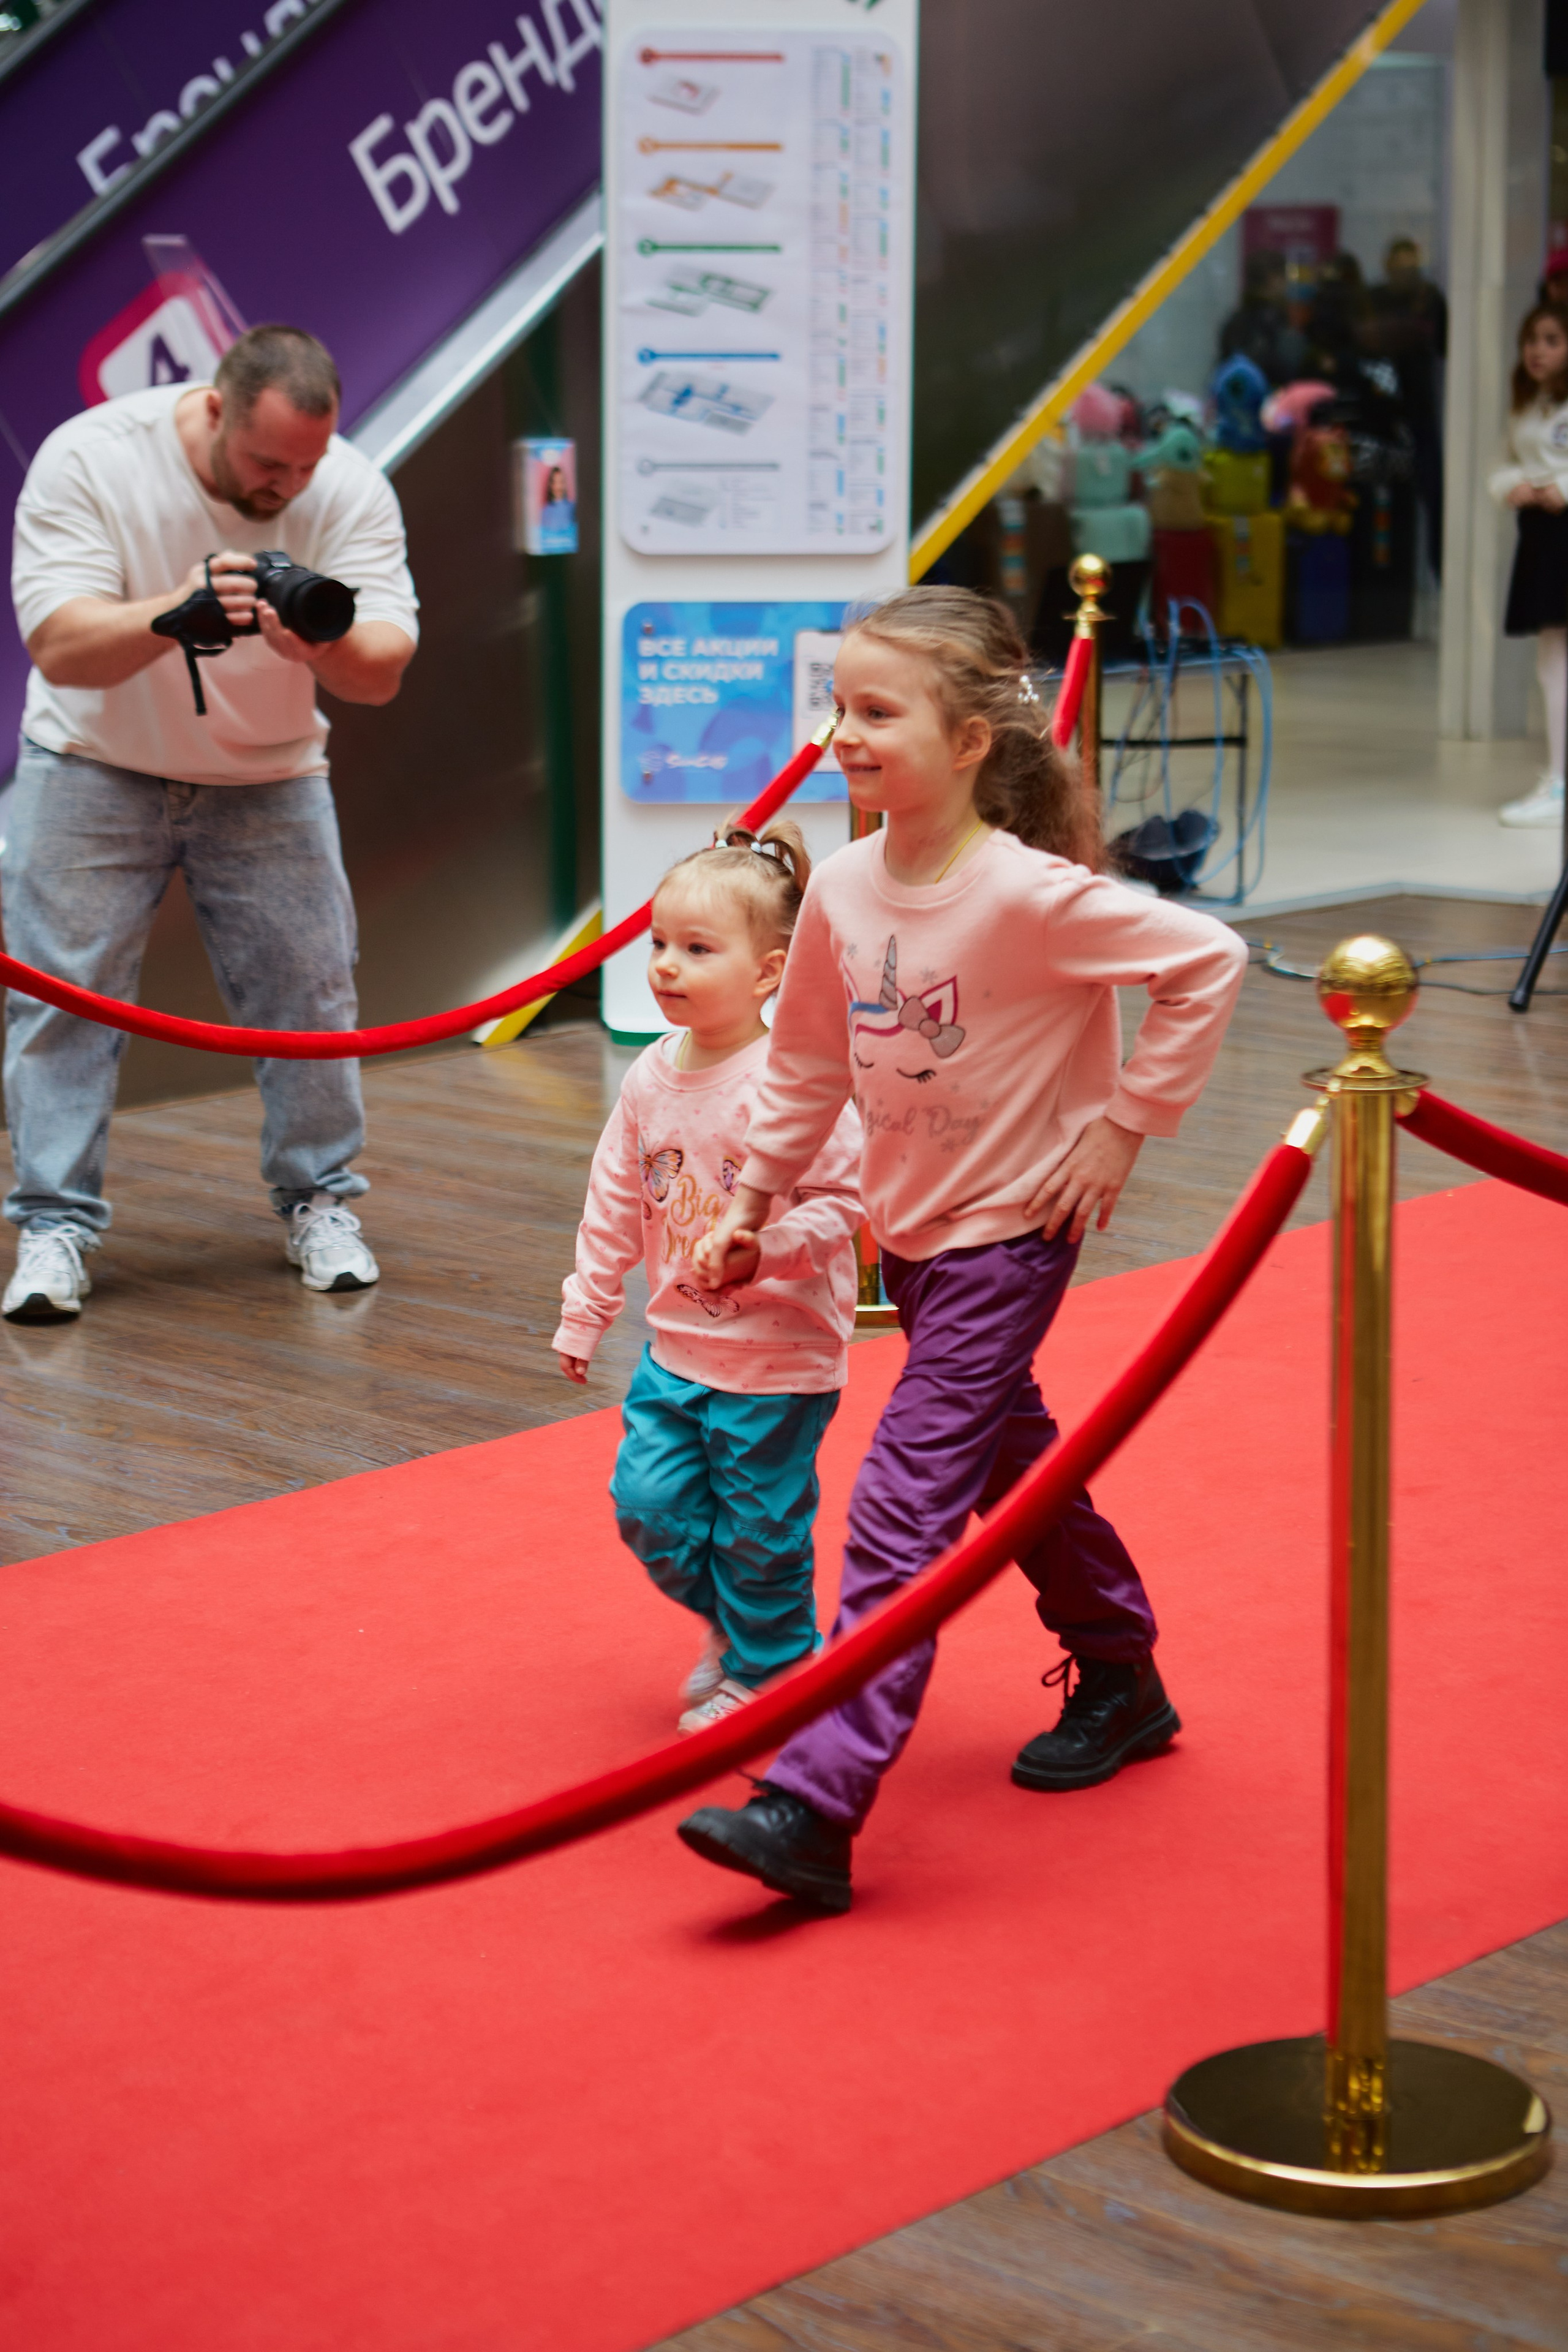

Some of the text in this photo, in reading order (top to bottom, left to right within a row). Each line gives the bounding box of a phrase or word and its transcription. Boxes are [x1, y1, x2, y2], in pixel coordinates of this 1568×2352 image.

[348, 0, 602, 235] Бренд
[638, 639, 778, 660] ВСЕ АКЦИИ
[638, 662, 764, 683] И СКИДКИ
[638, 686, 718, 706] ЗДЕСЬ
[858, 1096, 918, 1137] gical
[671, 1174, 723, 1232] Big
